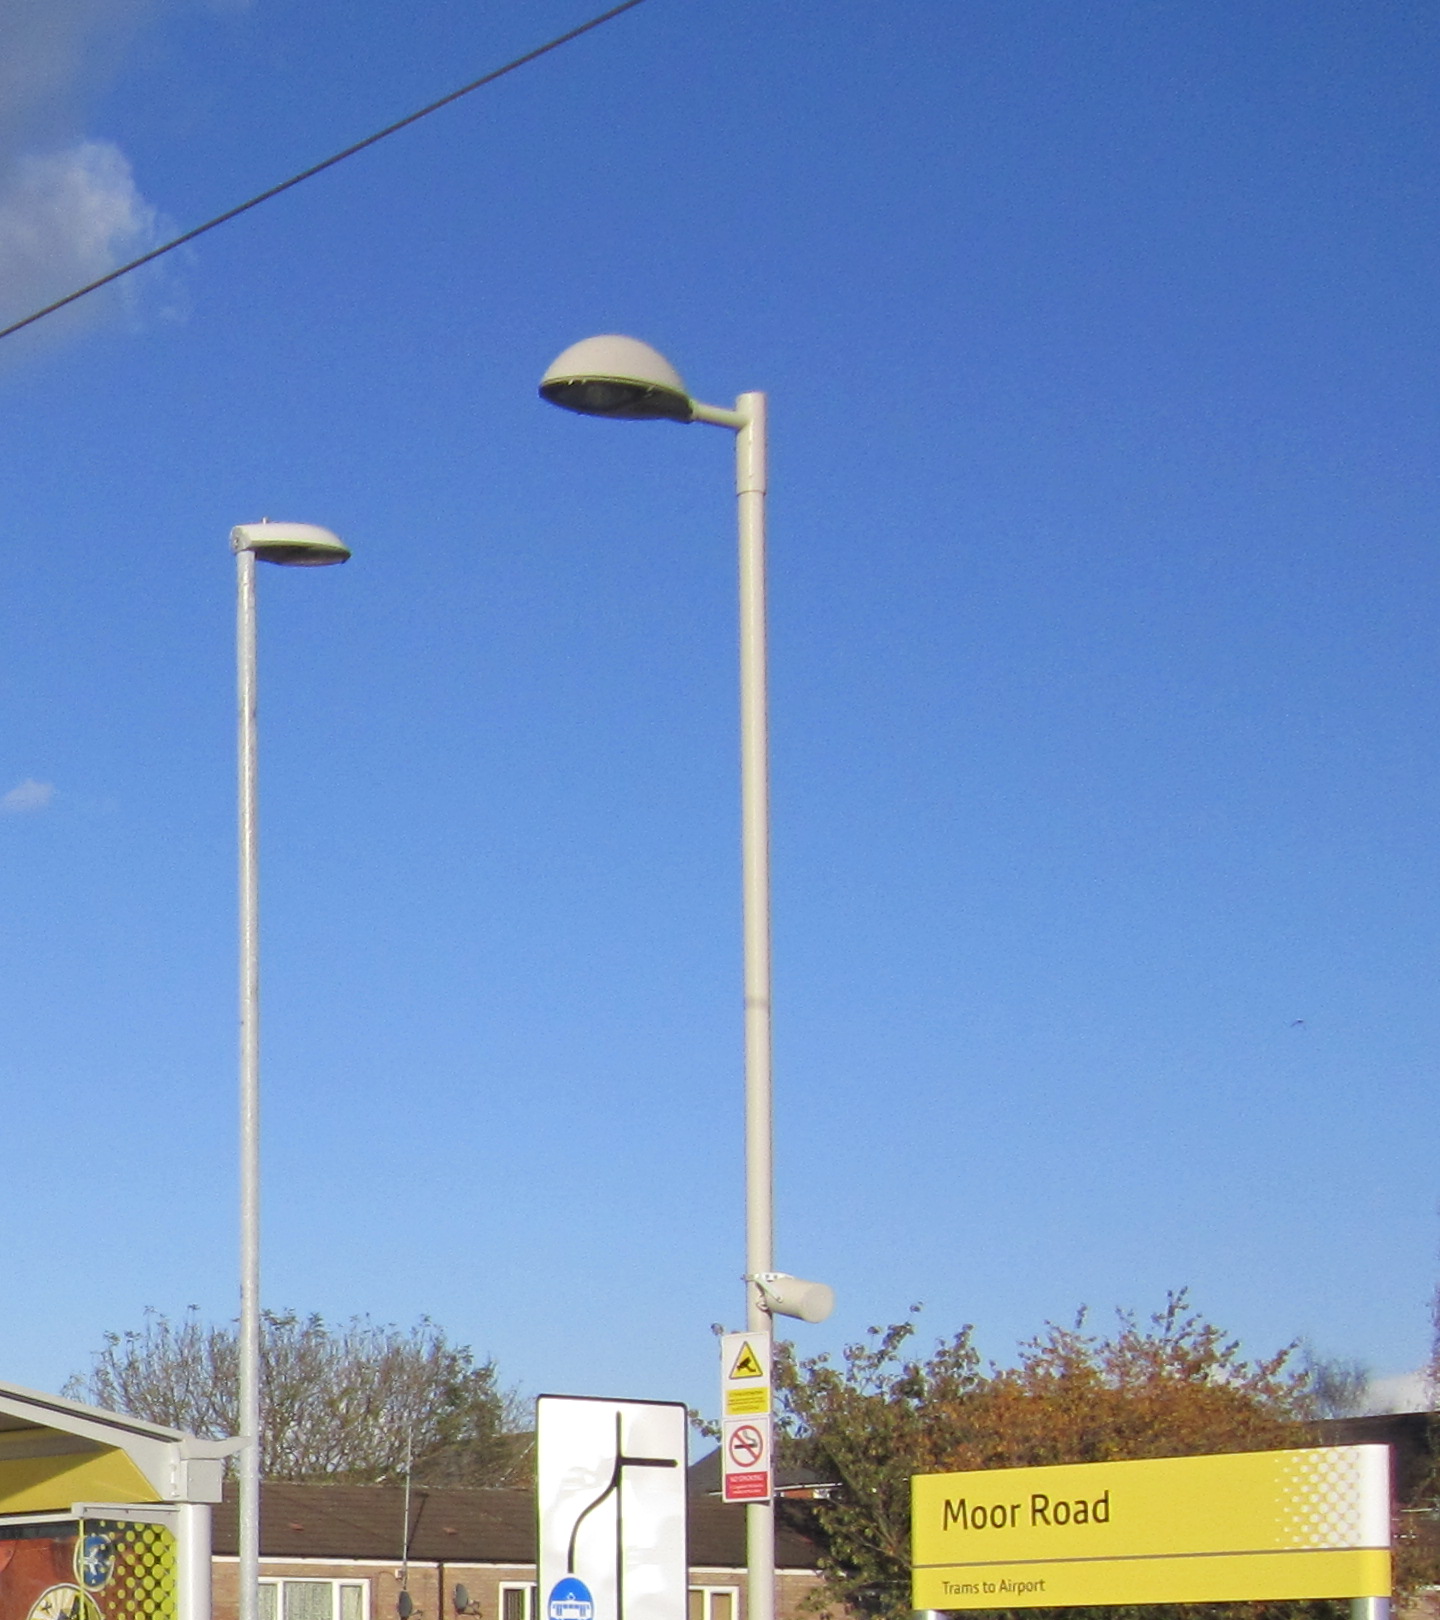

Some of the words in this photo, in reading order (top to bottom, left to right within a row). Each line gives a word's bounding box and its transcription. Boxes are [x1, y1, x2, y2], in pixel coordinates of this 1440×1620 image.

[943, 1498, 1020, 1531] Moor
[1031, 1490, 1109, 1527] Road
[942, 1581, 980, 1595] Trams
[983, 1582, 996, 1594] to
[999, 1579, 1045, 1596] Airport
